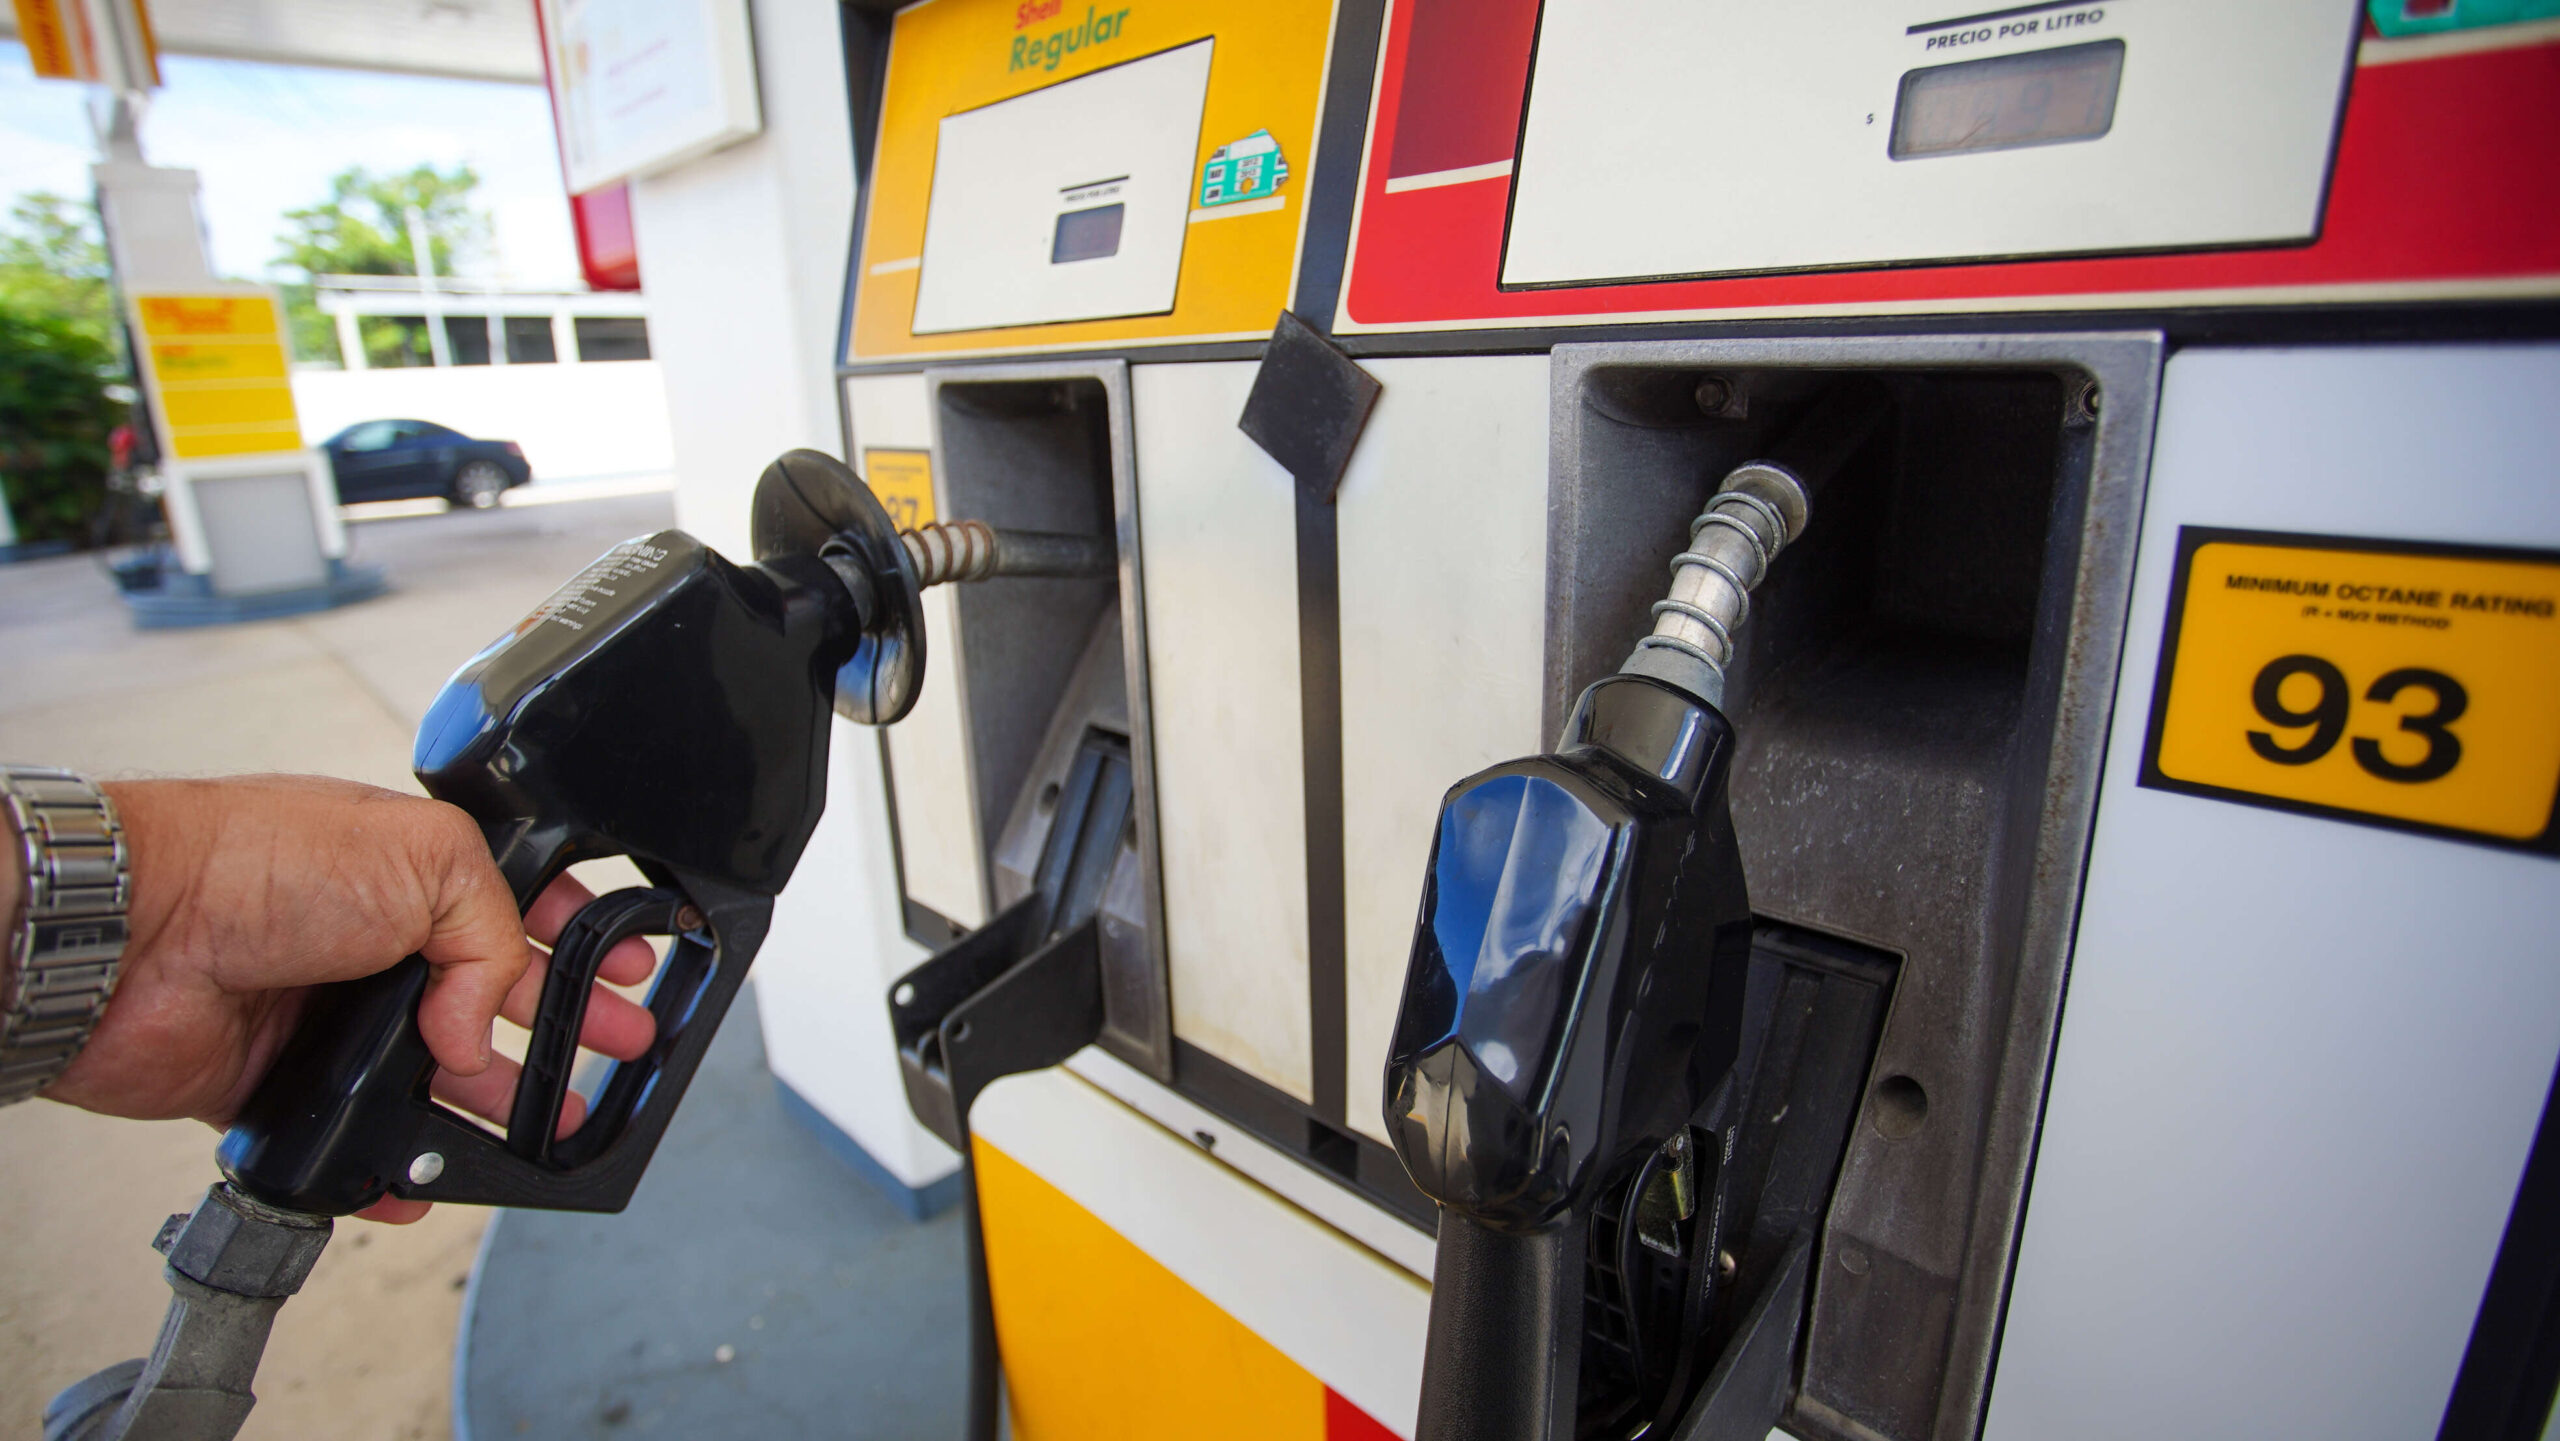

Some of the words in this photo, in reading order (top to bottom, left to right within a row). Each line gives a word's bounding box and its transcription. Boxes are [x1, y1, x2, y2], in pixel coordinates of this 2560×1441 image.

[1009, 5, 1131, 73] Regular
[1926, 28, 1992, 50] PRECIO
[2000, 20, 2040, 39] POR
[2046, 9, 2105, 31] LITRO
[2226, 574, 2330, 599] MINIMUM
[2336, 583, 2443, 608] OCTANE
[2450, 592, 2557, 619] RATING
[2246, 653, 2470, 785] 93
